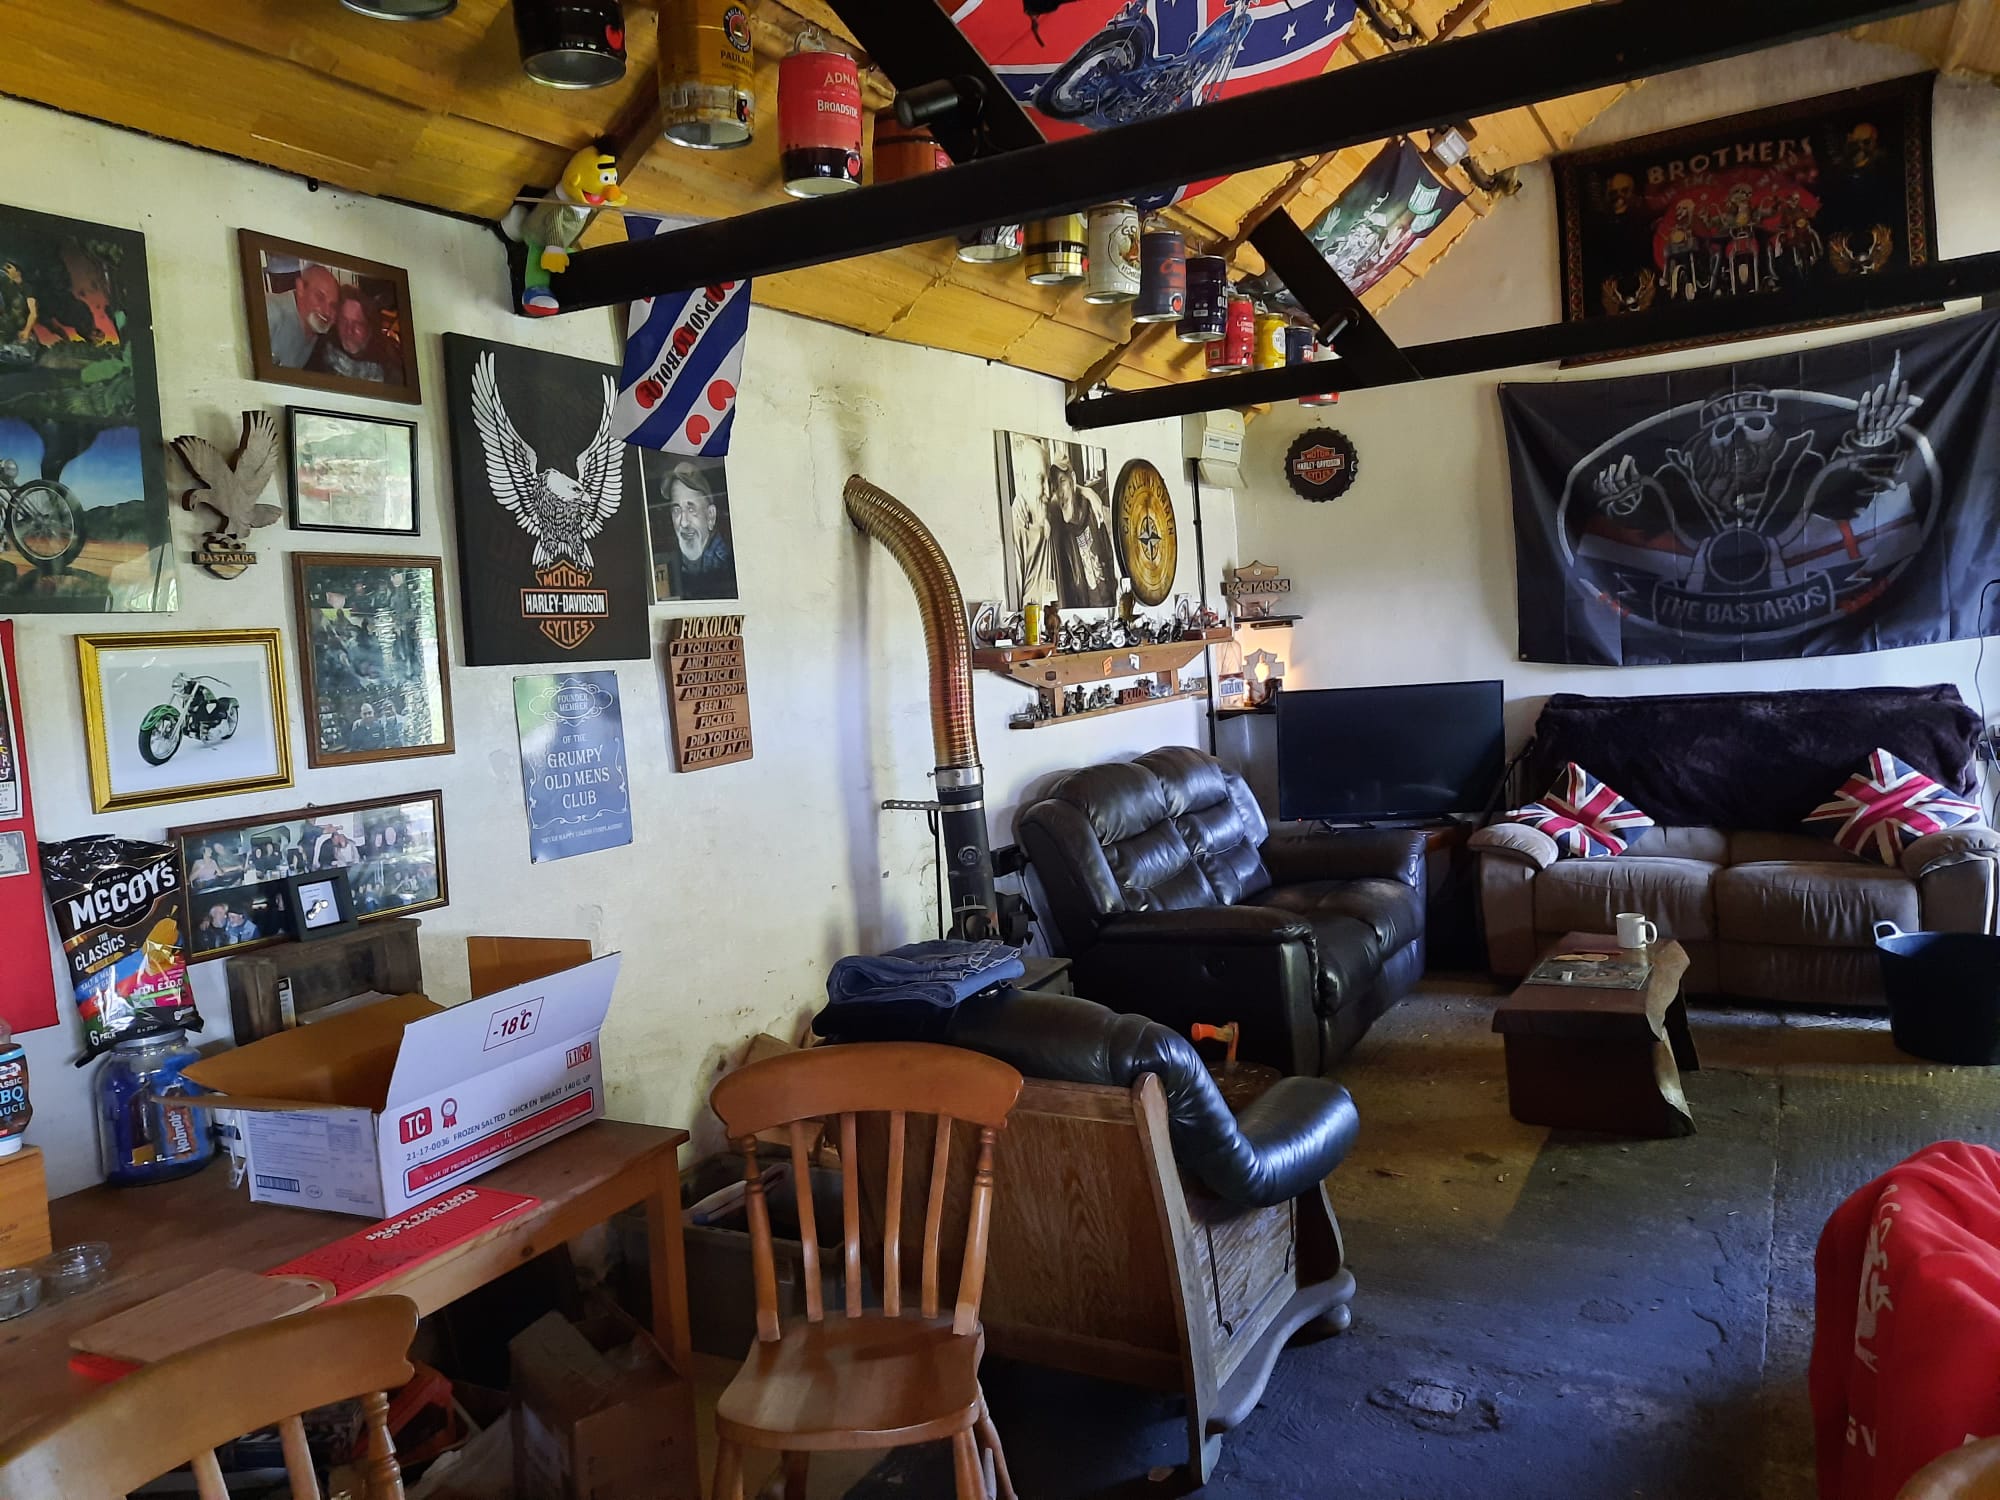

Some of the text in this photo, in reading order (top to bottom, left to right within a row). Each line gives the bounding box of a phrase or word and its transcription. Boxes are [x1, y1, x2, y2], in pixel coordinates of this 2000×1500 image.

[1647, 137, 1812, 184] BROTHERS
[1711, 393, 1767, 417] MEL
[1296, 458, 1341, 471] HARLEY-DAVIDSON
[199, 552, 255, 563] BASTARDS
[543, 565, 586, 587] MOTOR
[1226, 579, 1289, 594] BASTARDS
[524, 593, 606, 614] HARLEY-DAVIDSON
[1659, 595, 1699, 621] THE
[1704, 585, 1827, 625] BASTARDS
[545, 620, 589, 644] CYCLES
[680, 615, 745, 639] FUCKOLOGY
[687, 641, 707, 654] YOU
[708, 640, 731, 653] FUCK
[684, 656, 705, 669] AND
[680, 671, 707, 685] YOUR
[708, 669, 731, 682] FUCK
[557, 693, 588, 703] FOUNDER
[684, 687, 704, 699] AND
[559, 702, 588, 712] MEMBER
[698, 701, 719, 714] SEEN
[562, 735, 571, 744] OF
[690, 734, 707, 748] DID
[707, 731, 728, 745] YOU
[547, 745, 604, 769] GRUMPY
[687, 749, 712, 764] FUCK
[544, 767, 610, 791] OLD MENS
[562, 790, 597, 809] CLUB
[97, 932, 109, 942] THE
[75, 934, 127, 971] CLASSICS
[90, 1030, 100, 1046] 6
[453, 1123, 481, 1142] FROZEN
[480, 1112, 507, 1130] SALTED
[508, 1097, 538, 1117] CHICKEN
[539, 1086, 563, 1104] BREAST
[168, 1109, 192, 1153] Hobnobs
[405, 1112, 427, 1139] TC
